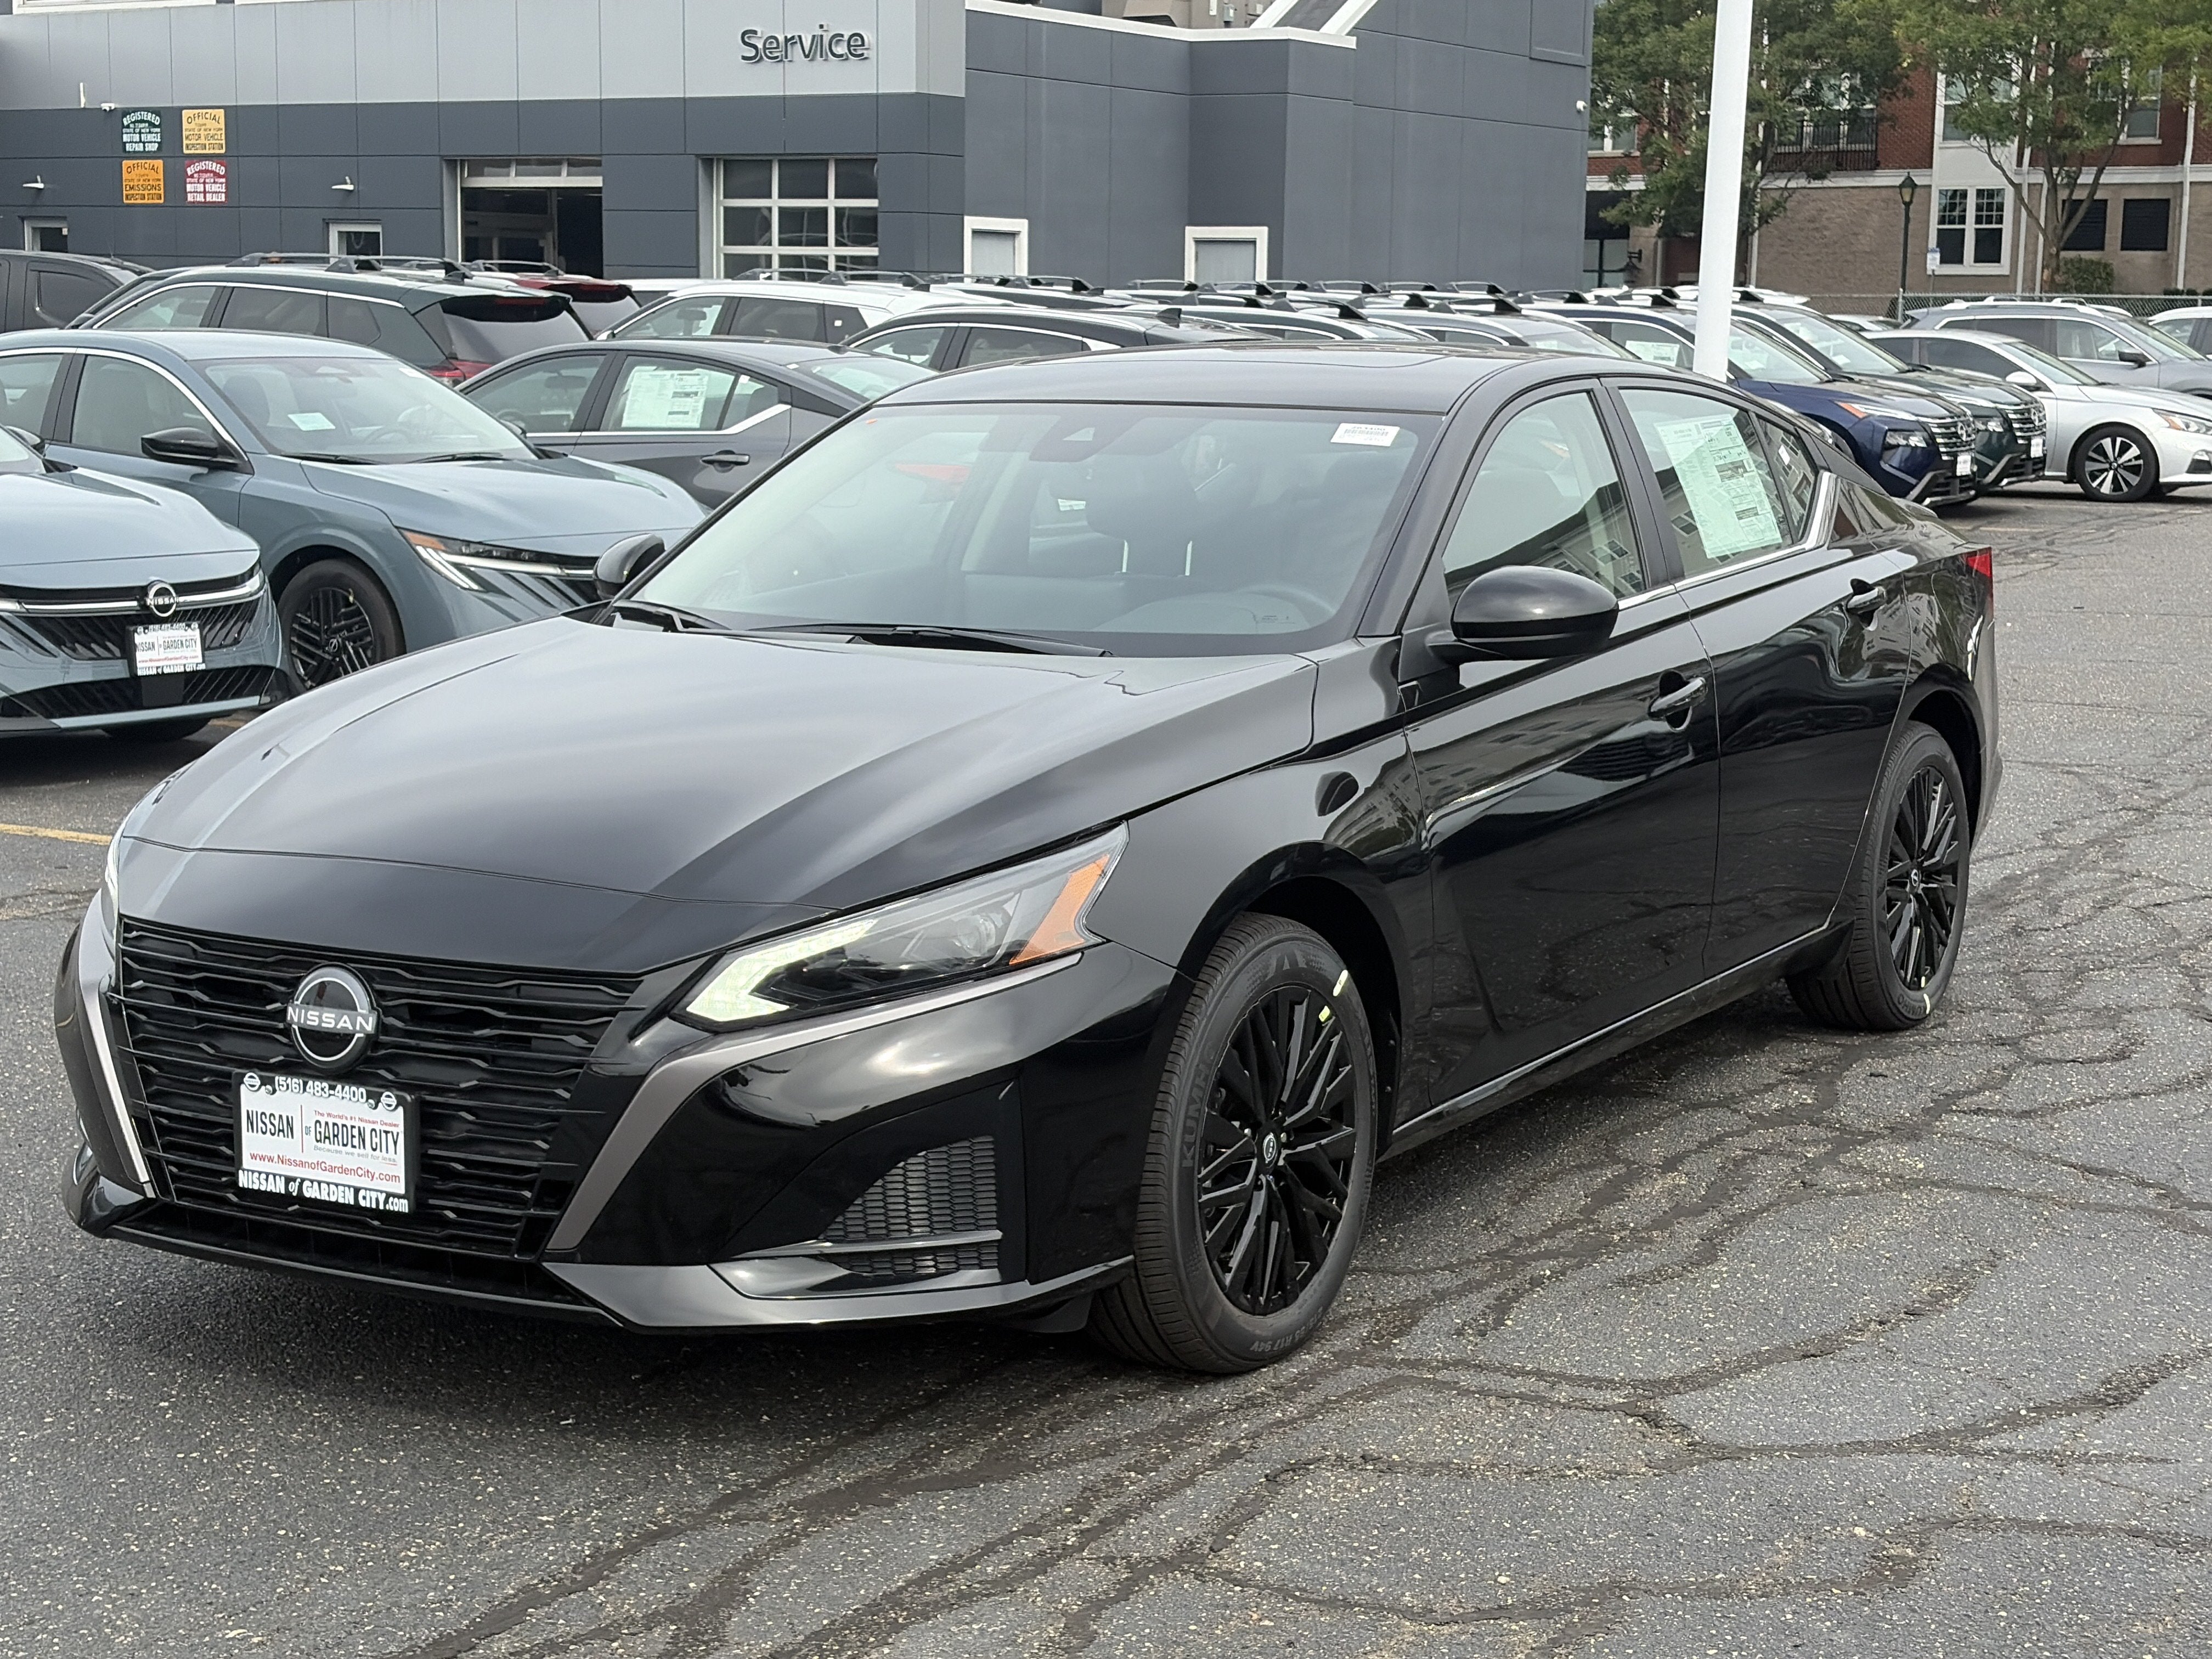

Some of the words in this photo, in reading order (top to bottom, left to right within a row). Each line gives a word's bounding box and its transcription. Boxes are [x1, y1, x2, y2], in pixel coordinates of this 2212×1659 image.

[741, 24, 867, 61] Service
[123, 111, 160, 126] REGISTERED
[187, 111, 221, 124] OFFICIAL
[123, 133, 139, 142] MOTOR
[141, 133, 161, 142] VEHICLE
[126, 143, 143, 151] REPAIR
[145, 143, 158, 151] SHOP
[126, 162, 159, 174] OFFICIAL
[187, 161, 225, 176] REGISTERED
[187, 184, 204, 192] MOTOR
[205, 183, 226, 192] VEHICLE
[188, 193, 205, 201] RETAIL
[206, 193, 225, 201] DEALER
[147, 596, 179, 606] NISSAN
[163, 639, 184, 650] GARDEN
[185, 637, 197, 648] CITY
[137, 667, 156, 676] NISSAN
[163, 664, 184, 674] GARDEN
[287, 1006, 373, 1031] NISSAN
[275, 1076, 303, 1093] (516)
[306, 1081, 366, 1103] 483-4400
[1181, 1039, 1216, 1168] KUMHO
[246, 1109, 294, 1139] NISSAN
[304, 1125, 312, 1135] OF
[314, 1120, 366, 1150] GARDEN
[370, 1128, 399, 1155] CITY
[314, 1145, 343, 1155] Because
[250, 1152, 400, 1183] www.NissanofGardenCity.com
[238, 1170, 285, 1194] NISSAN
[289, 1178, 301, 1196] of
[302, 1182, 354, 1205] GARDEN
[358, 1189, 408, 1213] CITY.com
[1250, 1341, 1273, 1352] 94V
